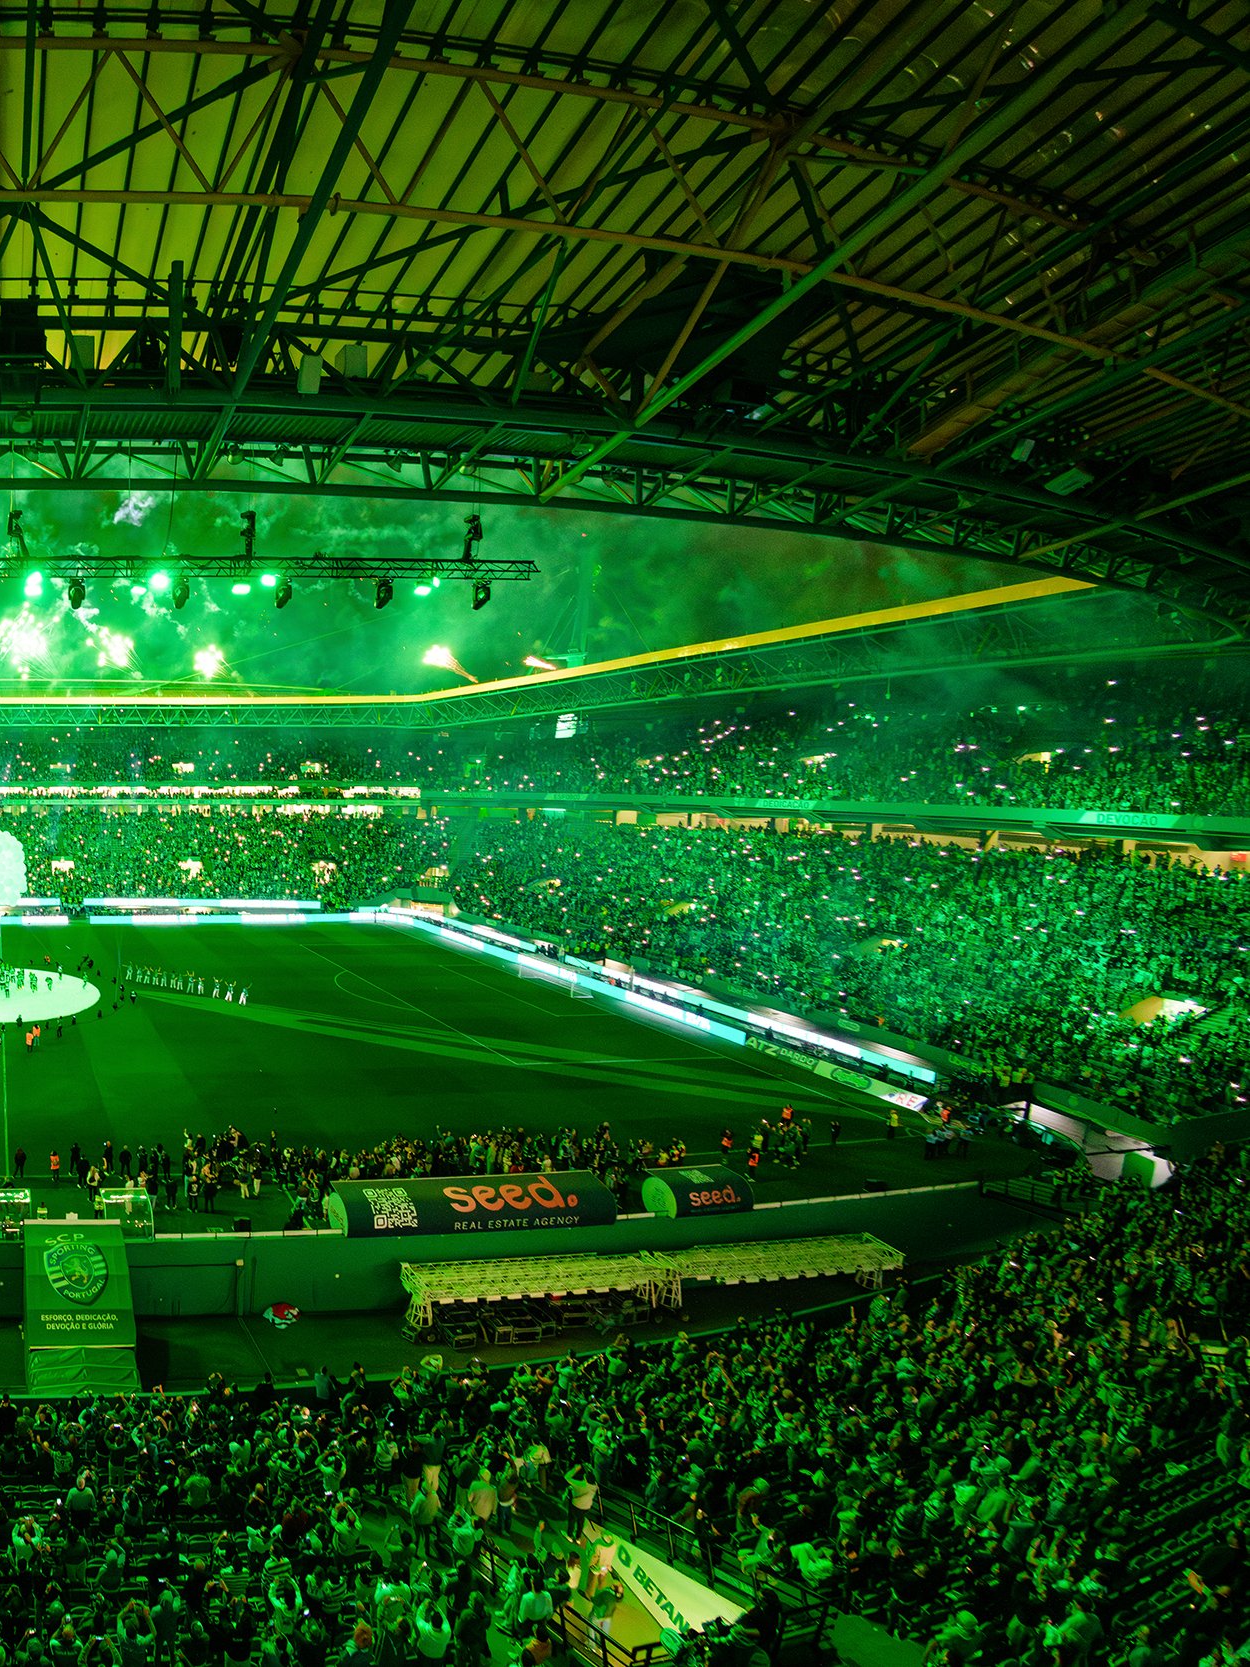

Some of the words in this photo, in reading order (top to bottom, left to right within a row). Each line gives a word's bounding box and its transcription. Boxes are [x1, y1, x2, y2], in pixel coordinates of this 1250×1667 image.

[745, 1036, 779, 1057] ATZ
[443, 1176, 579, 1213] seed.
[689, 1184, 742, 1207] seed.
[454, 1221, 483, 1231] REAL
[488, 1218, 529, 1229] ESTATE
[533, 1215, 580, 1226] AGENCY
[45, 1233, 85, 1246] SCP
[49, 1244, 96, 1265] SPORTING
[63, 1279, 106, 1299] PORTUGAL
[46, 1322, 81, 1331] DEVOÇÃO
[88, 1322, 114, 1330] GLÓRIA
[632, 1565, 691, 1635] BETAN
